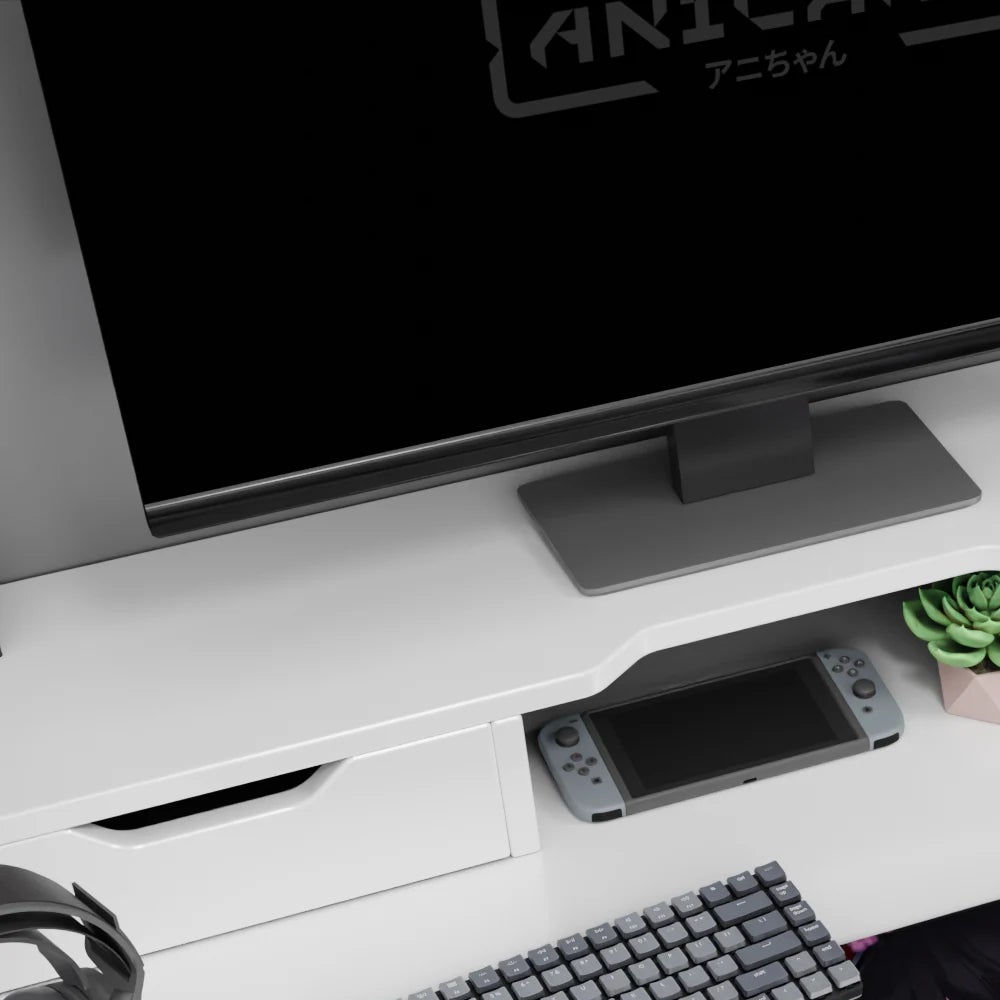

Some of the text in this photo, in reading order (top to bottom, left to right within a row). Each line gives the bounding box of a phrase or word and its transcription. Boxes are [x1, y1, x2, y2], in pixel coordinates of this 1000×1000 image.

[705, 40, 848, 89] アニちゃん
